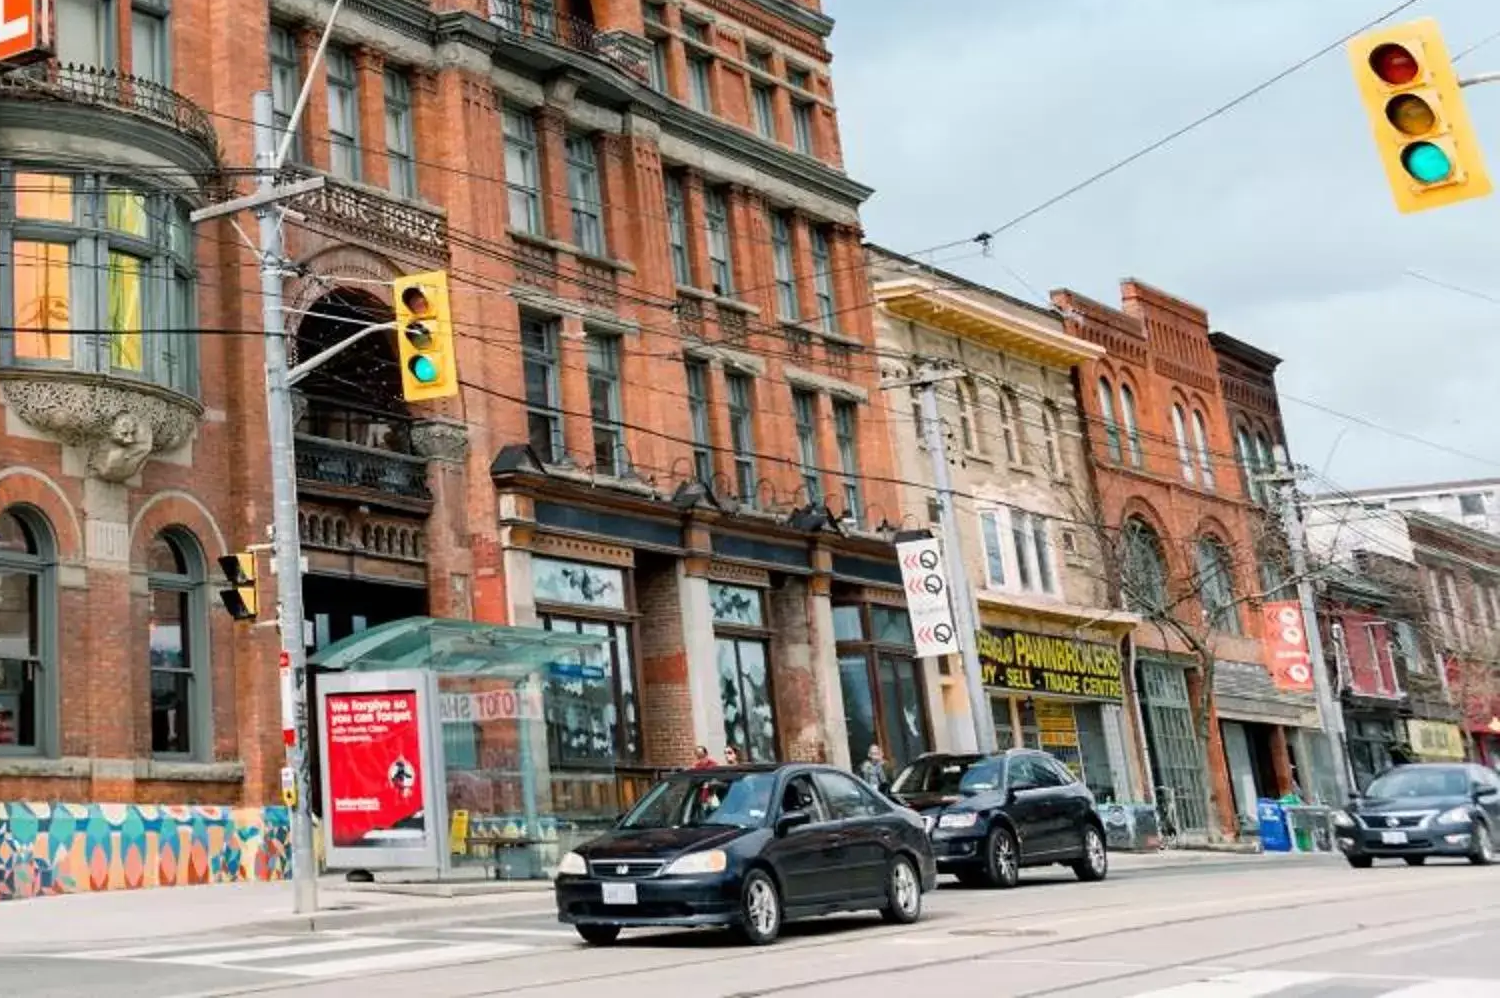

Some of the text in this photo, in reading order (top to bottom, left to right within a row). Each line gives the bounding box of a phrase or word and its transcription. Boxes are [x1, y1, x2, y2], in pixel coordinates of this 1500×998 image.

[1013, 632, 1119, 677] PAWNBROKERS
[1006, 667, 1034, 689] SELL
[1043, 671, 1081, 695] TRADE
[1082, 676, 1122, 697] CENTRE
